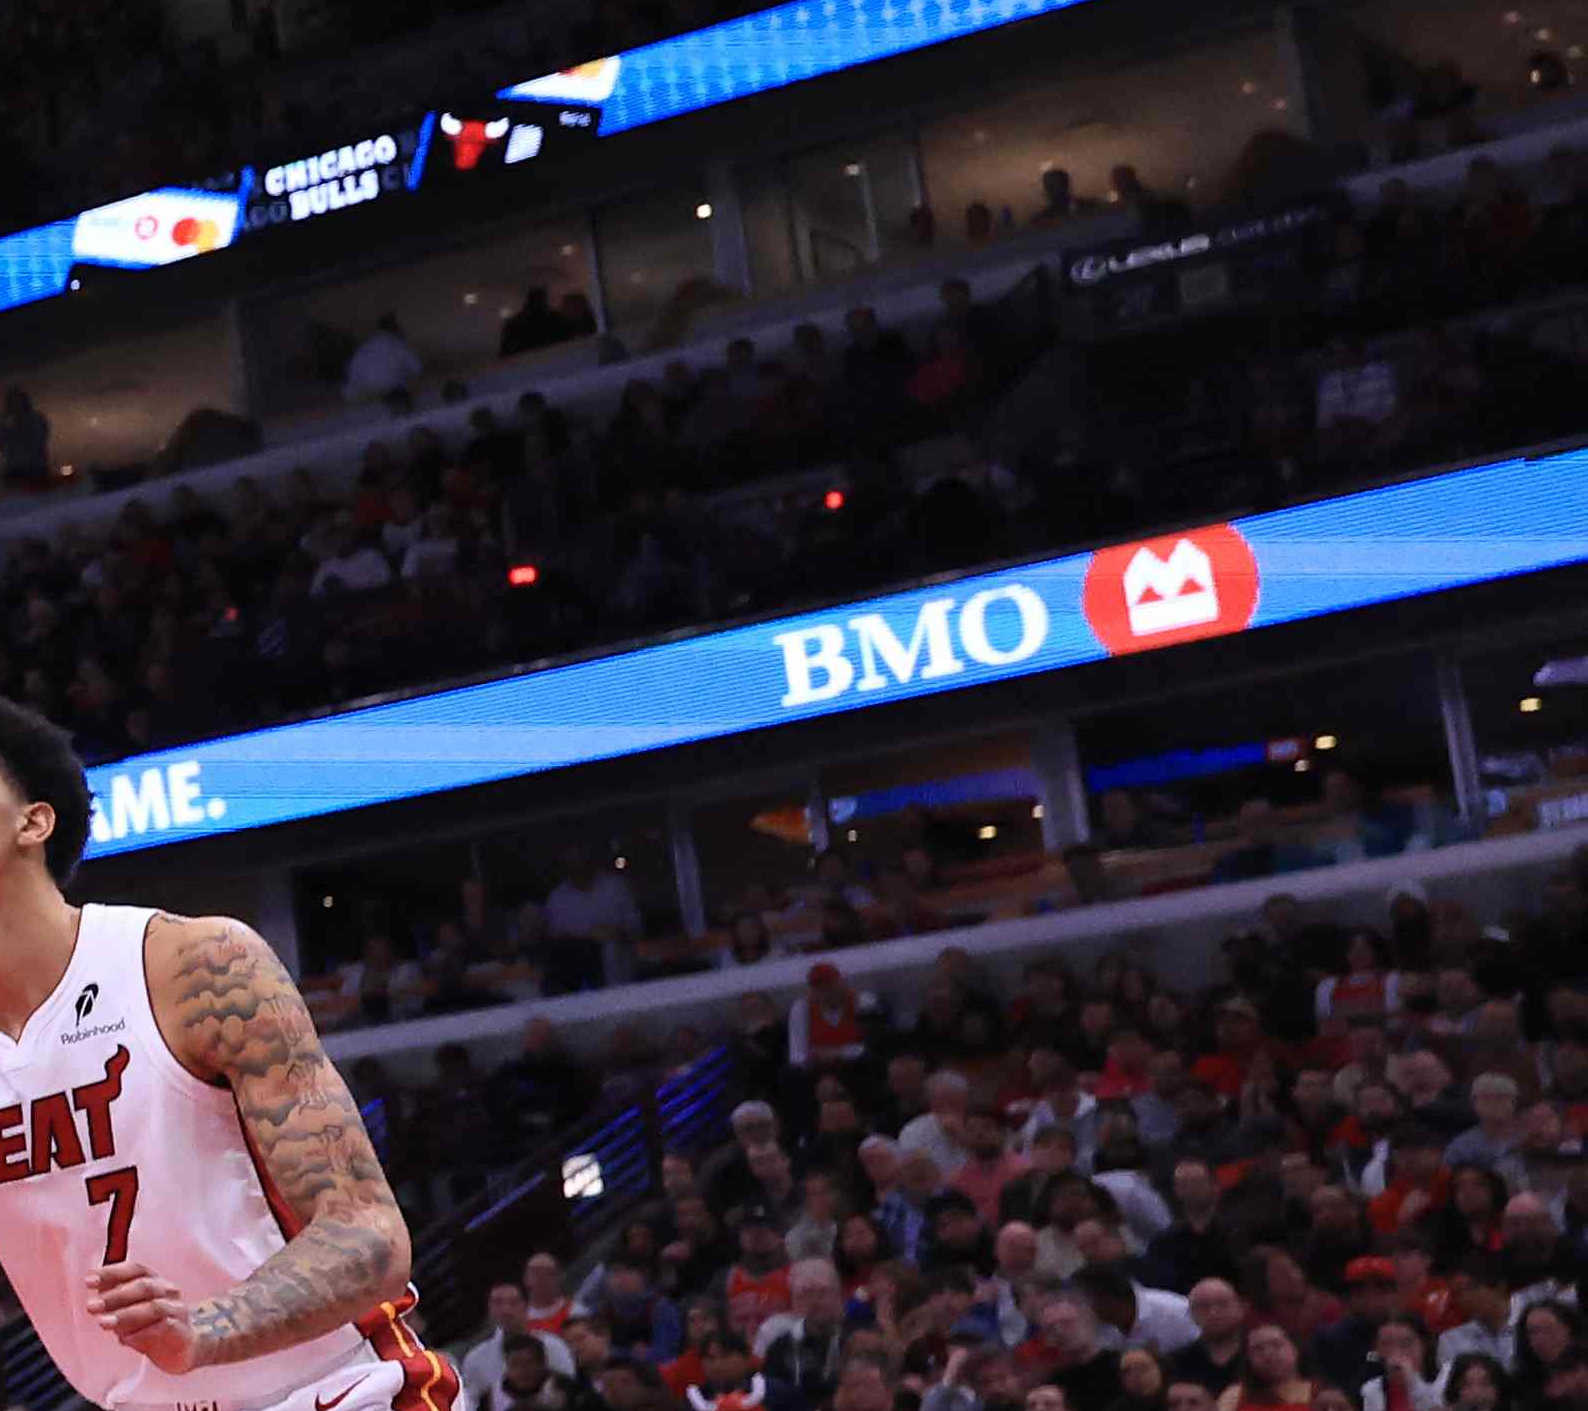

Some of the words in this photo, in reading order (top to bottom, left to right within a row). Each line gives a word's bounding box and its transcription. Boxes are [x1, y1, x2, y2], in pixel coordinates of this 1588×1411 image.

[264, 135, 398, 197] CHICAGO
[288, 169, 380, 221] BULLS
[774, 584, 1050, 708] BMO
[59, 1016, 127, 1047] Robinhood
[87, 1167, 141, 1266] 7
